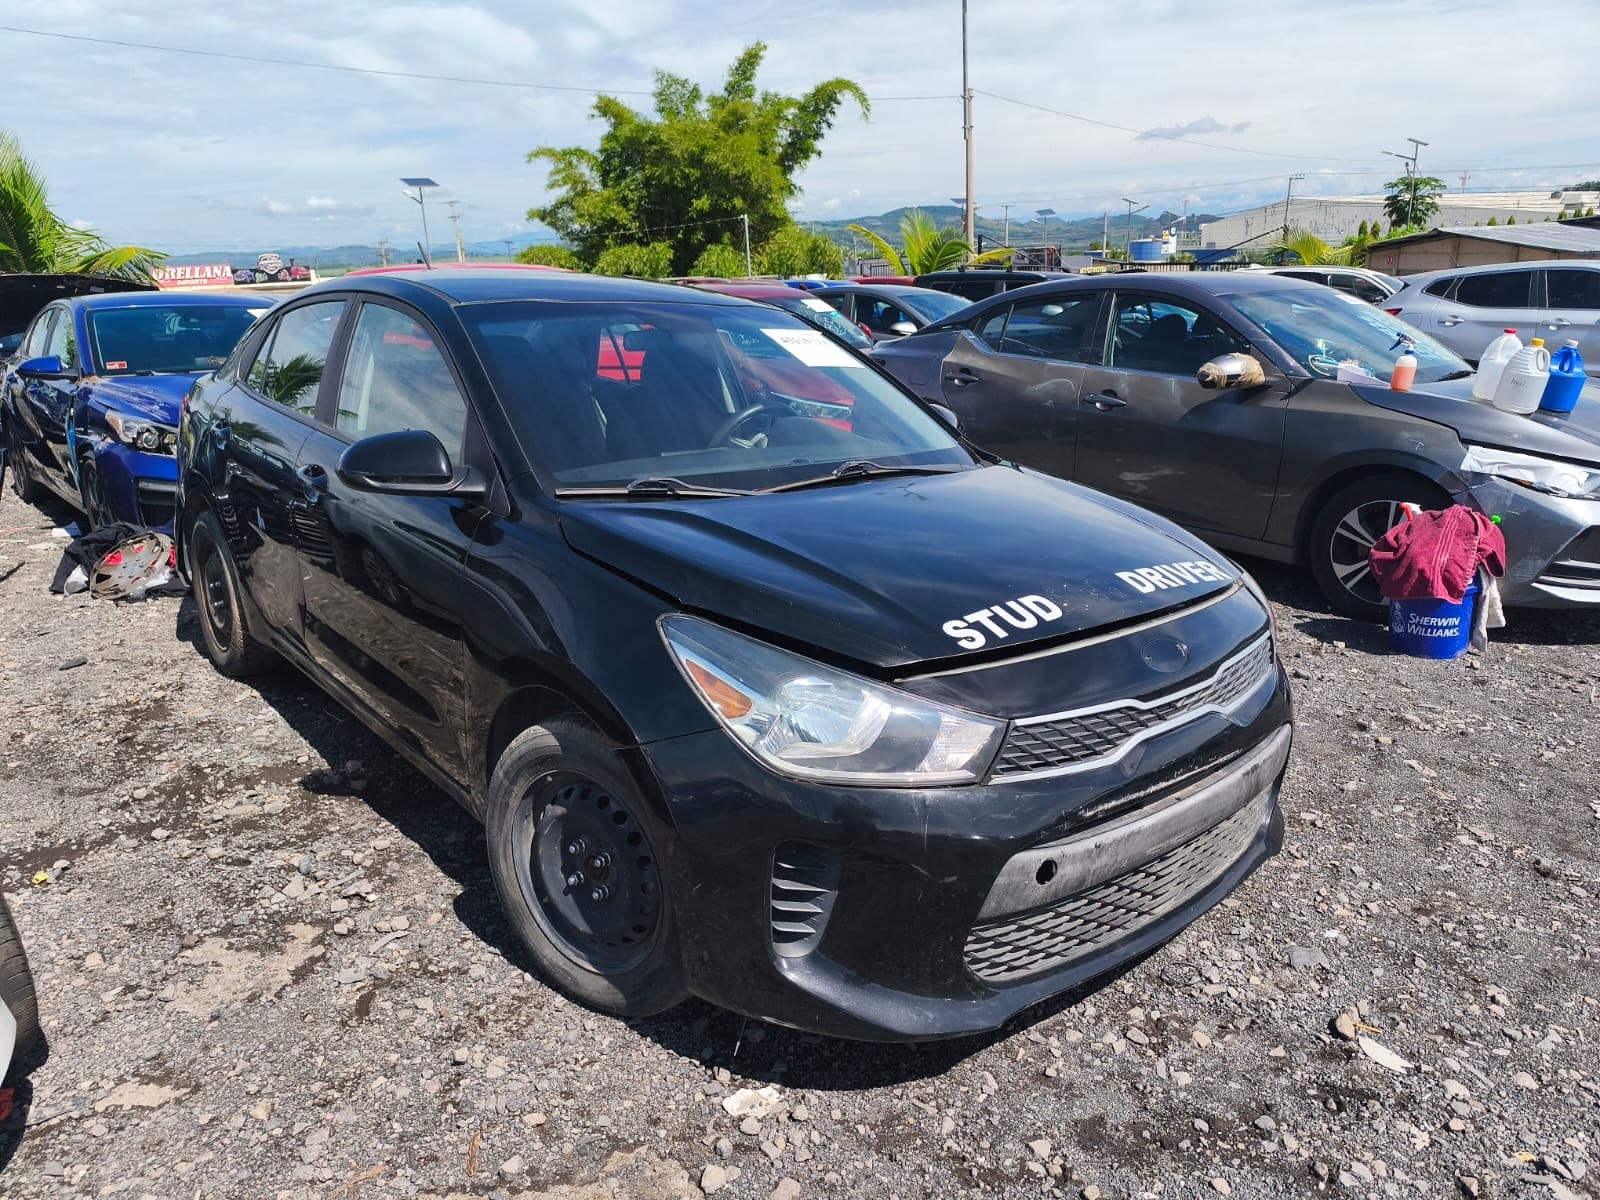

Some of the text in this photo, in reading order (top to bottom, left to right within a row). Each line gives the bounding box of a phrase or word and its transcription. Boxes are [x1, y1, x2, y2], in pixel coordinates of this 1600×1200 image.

[942, 561, 1232, 650] STUD DRIVER
[1409, 613, 1460, 627] SHERWIN
[1407, 623, 1460, 637] WILLIAMS
